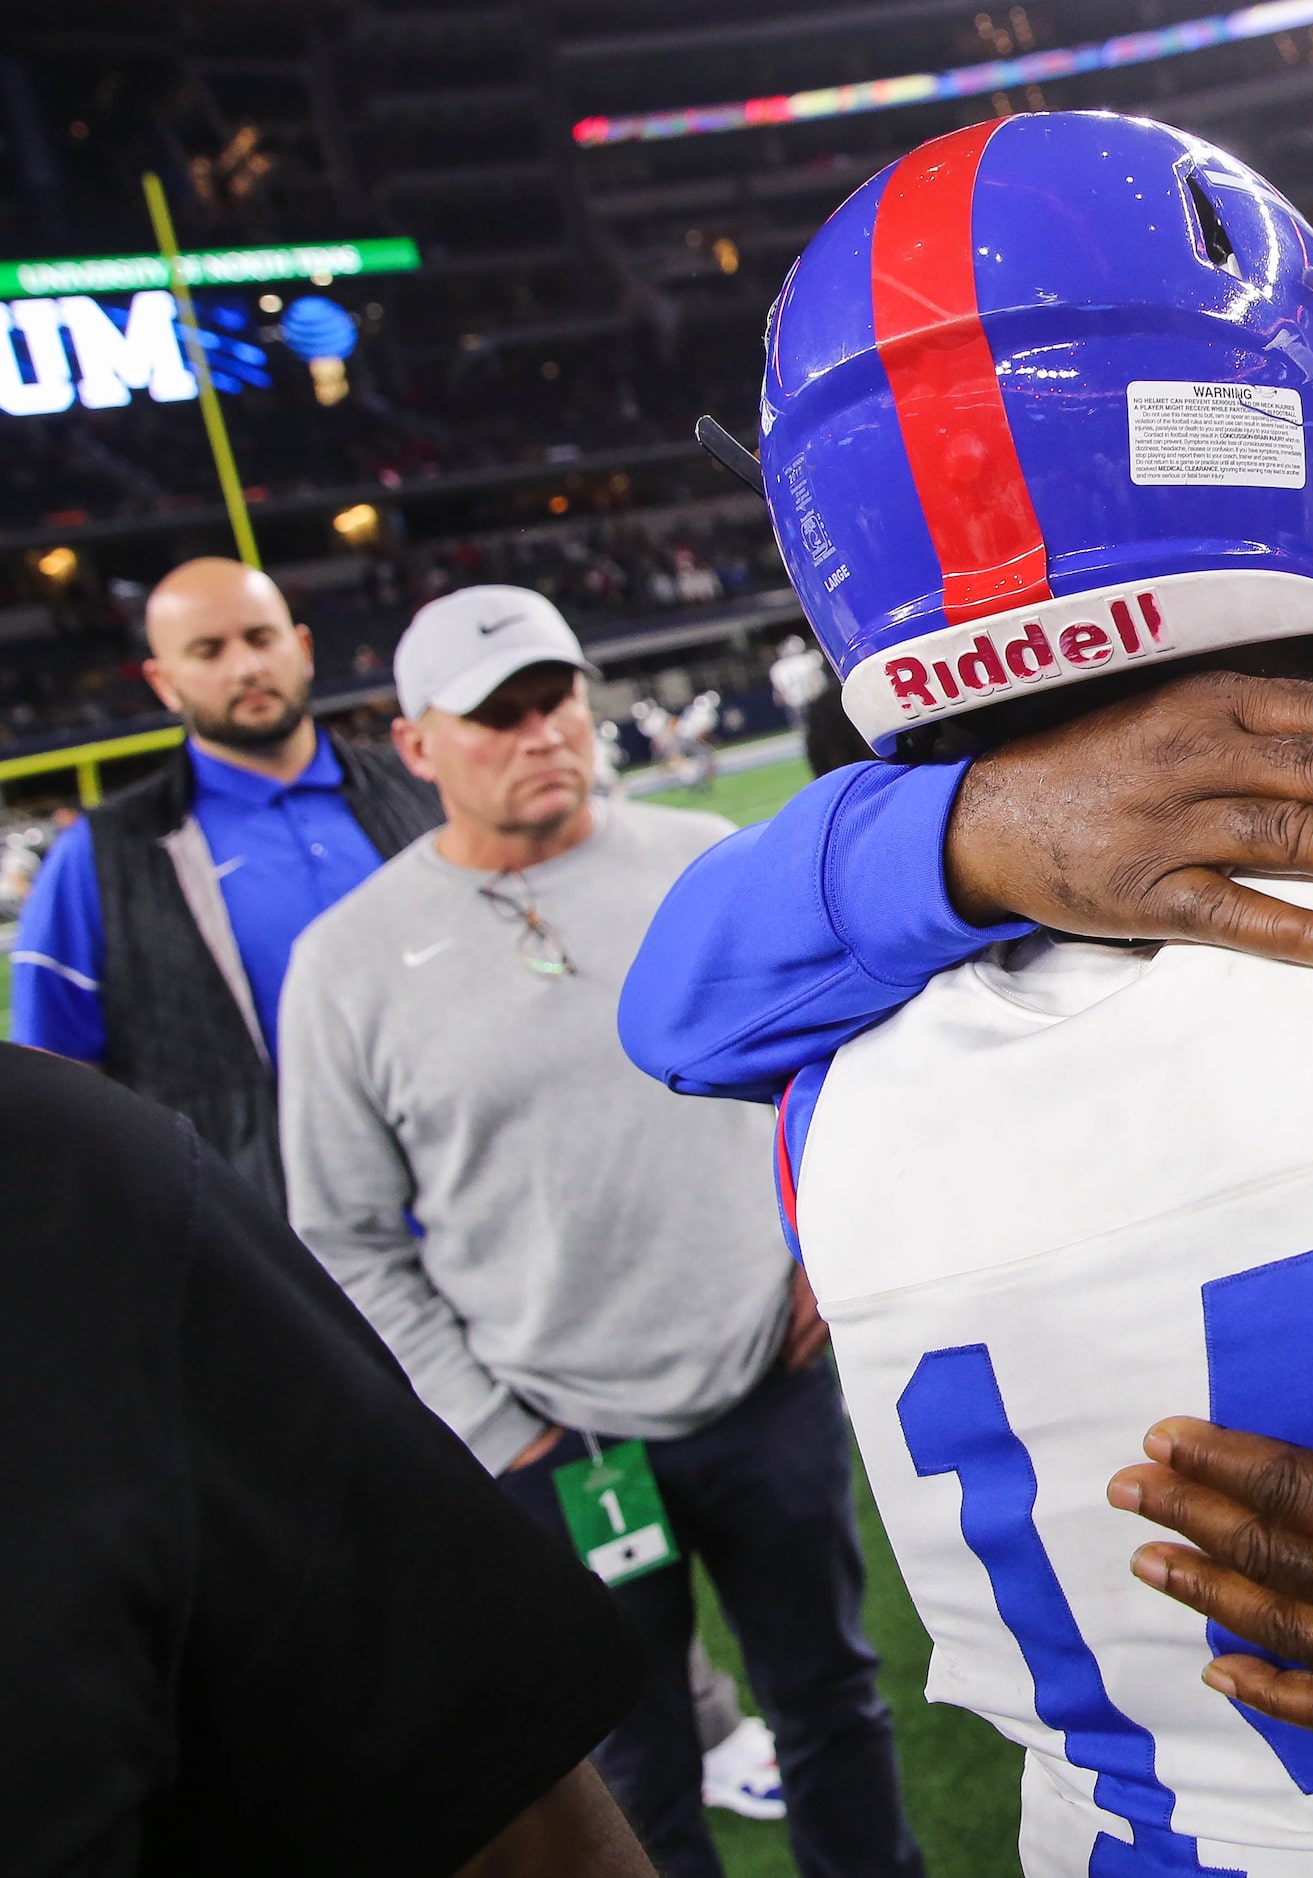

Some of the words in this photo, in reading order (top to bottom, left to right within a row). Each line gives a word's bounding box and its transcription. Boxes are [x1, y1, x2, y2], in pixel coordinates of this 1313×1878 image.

[1193, 386, 1252, 400] WARNING
[1273, 410, 1296, 418] FOOTBALL
[824, 562, 851, 593] LARGE
[884, 586, 1173, 719] Riddell
